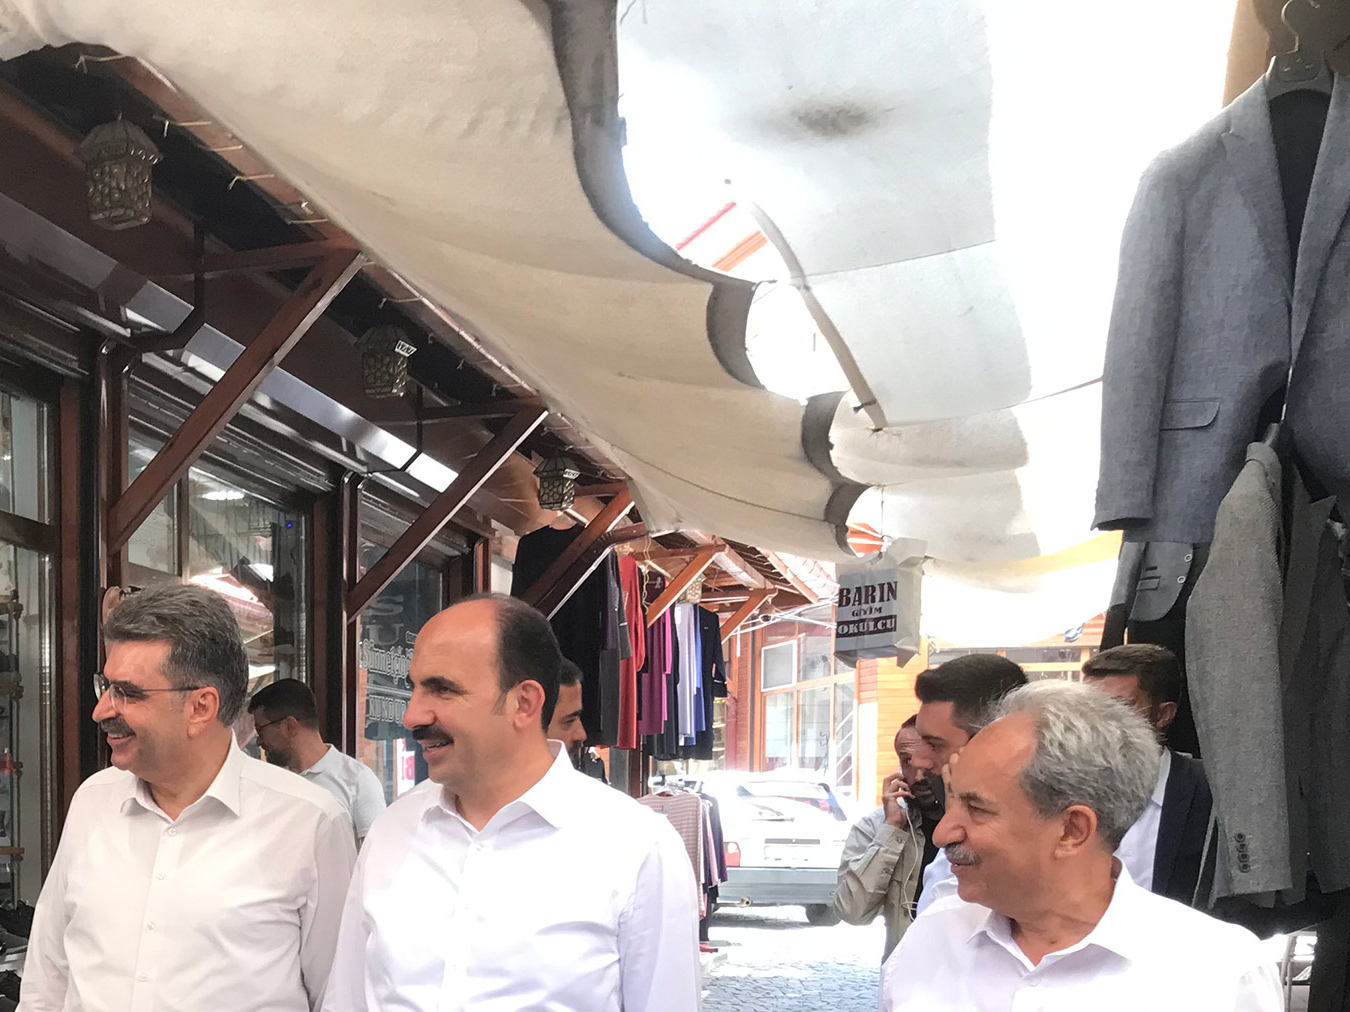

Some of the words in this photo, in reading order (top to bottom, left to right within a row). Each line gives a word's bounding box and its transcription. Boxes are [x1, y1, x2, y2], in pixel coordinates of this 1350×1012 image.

[838, 581, 898, 607] BARIN
[837, 618, 896, 635] OKULCU
[361, 639, 414, 689] Sünnetçio
[369, 694, 407, 722] KUNDUR
